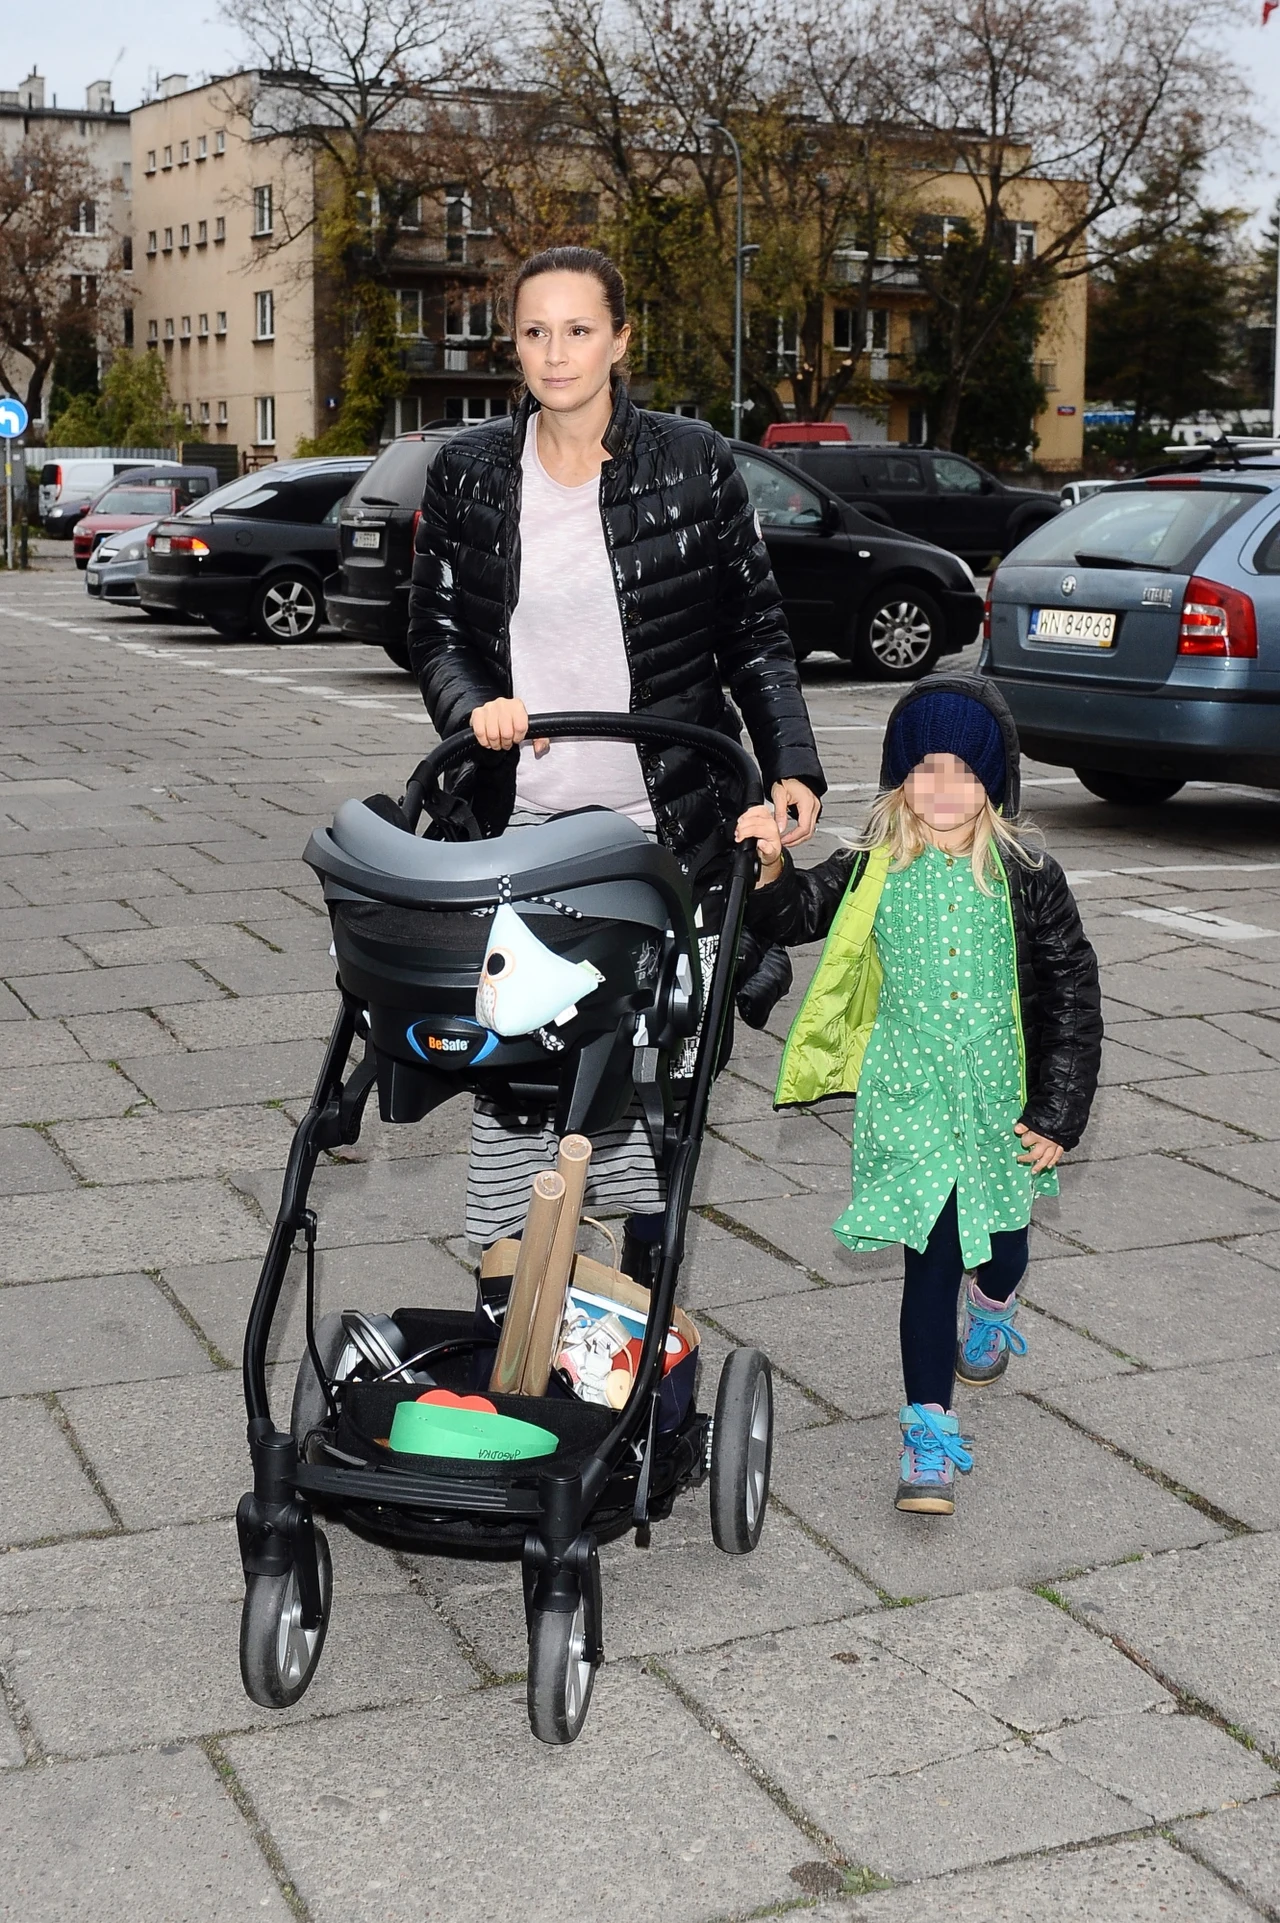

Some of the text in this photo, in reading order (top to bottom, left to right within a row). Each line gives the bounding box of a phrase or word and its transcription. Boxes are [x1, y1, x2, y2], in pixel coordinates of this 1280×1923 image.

[1040, 611, 1062, 634] WN
[1065, 613, 1113, 638] 84968
[428, 1036, 468, 1051] BeSafe
